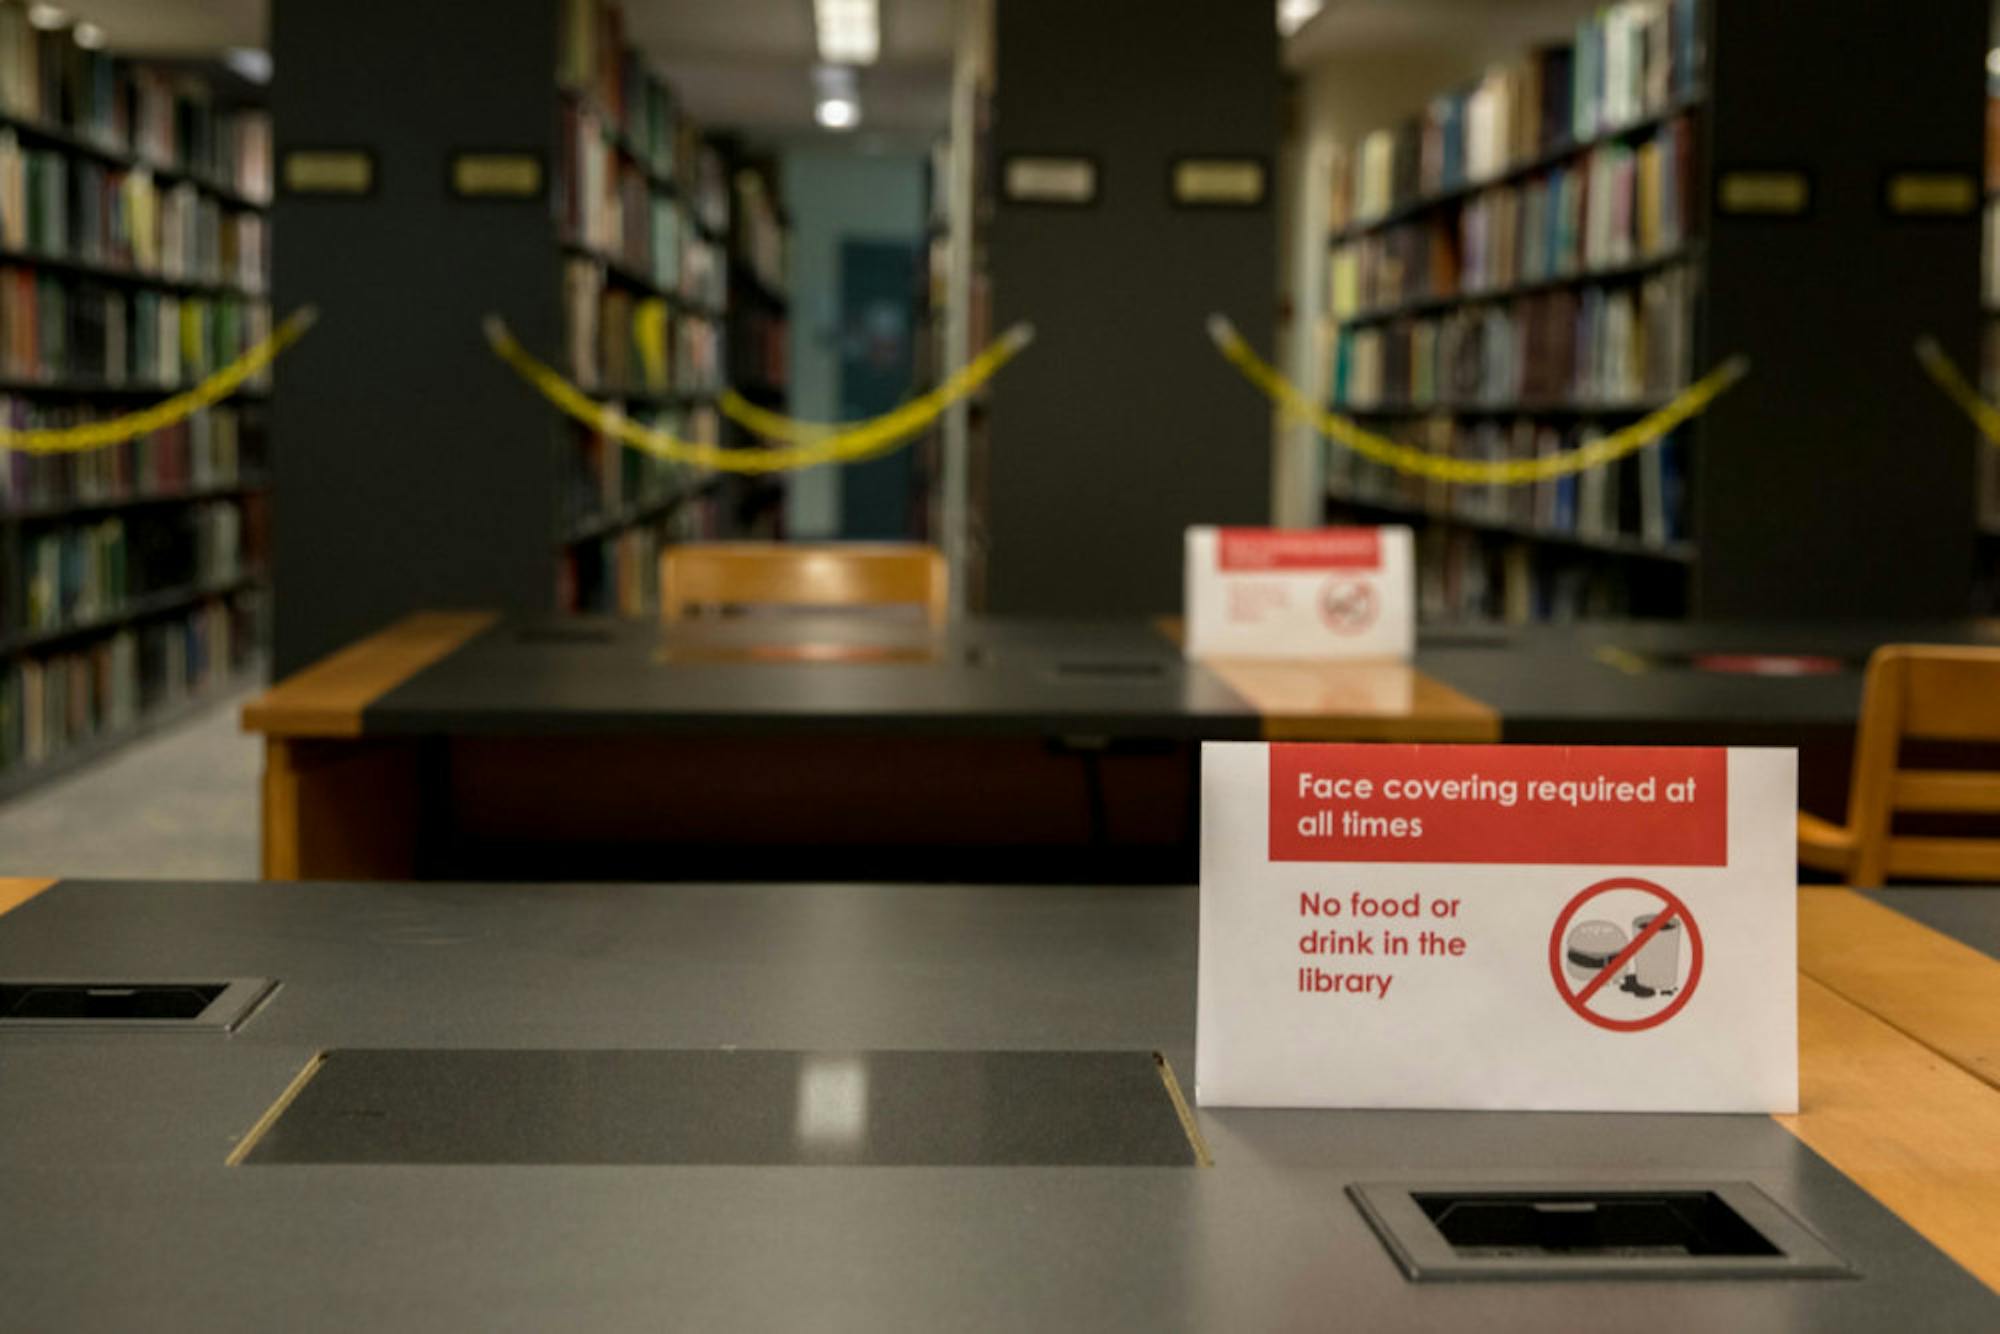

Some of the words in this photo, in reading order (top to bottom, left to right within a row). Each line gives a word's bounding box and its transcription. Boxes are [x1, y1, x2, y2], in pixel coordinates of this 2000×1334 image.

[1299, 773, 1373, 799] Face
[1383, 774, 1517, 806] covering
[1528, 776, 1655, 806] required
[1666, 777, 1695, 802] at
[1298, 811, 1332, 836] all
[1343, 811, 1422, 837] times
[1300, 893, 1341, 916] No
[1351, 892, 1419, 917] food
[1432, 900, 1458, 917] or
[1300, 930, 1372, 955] drink
[1384, 931, 1408, 954] in
[1419, 931, 1466, 956] the
[1300, 968, 1391, 997] library
